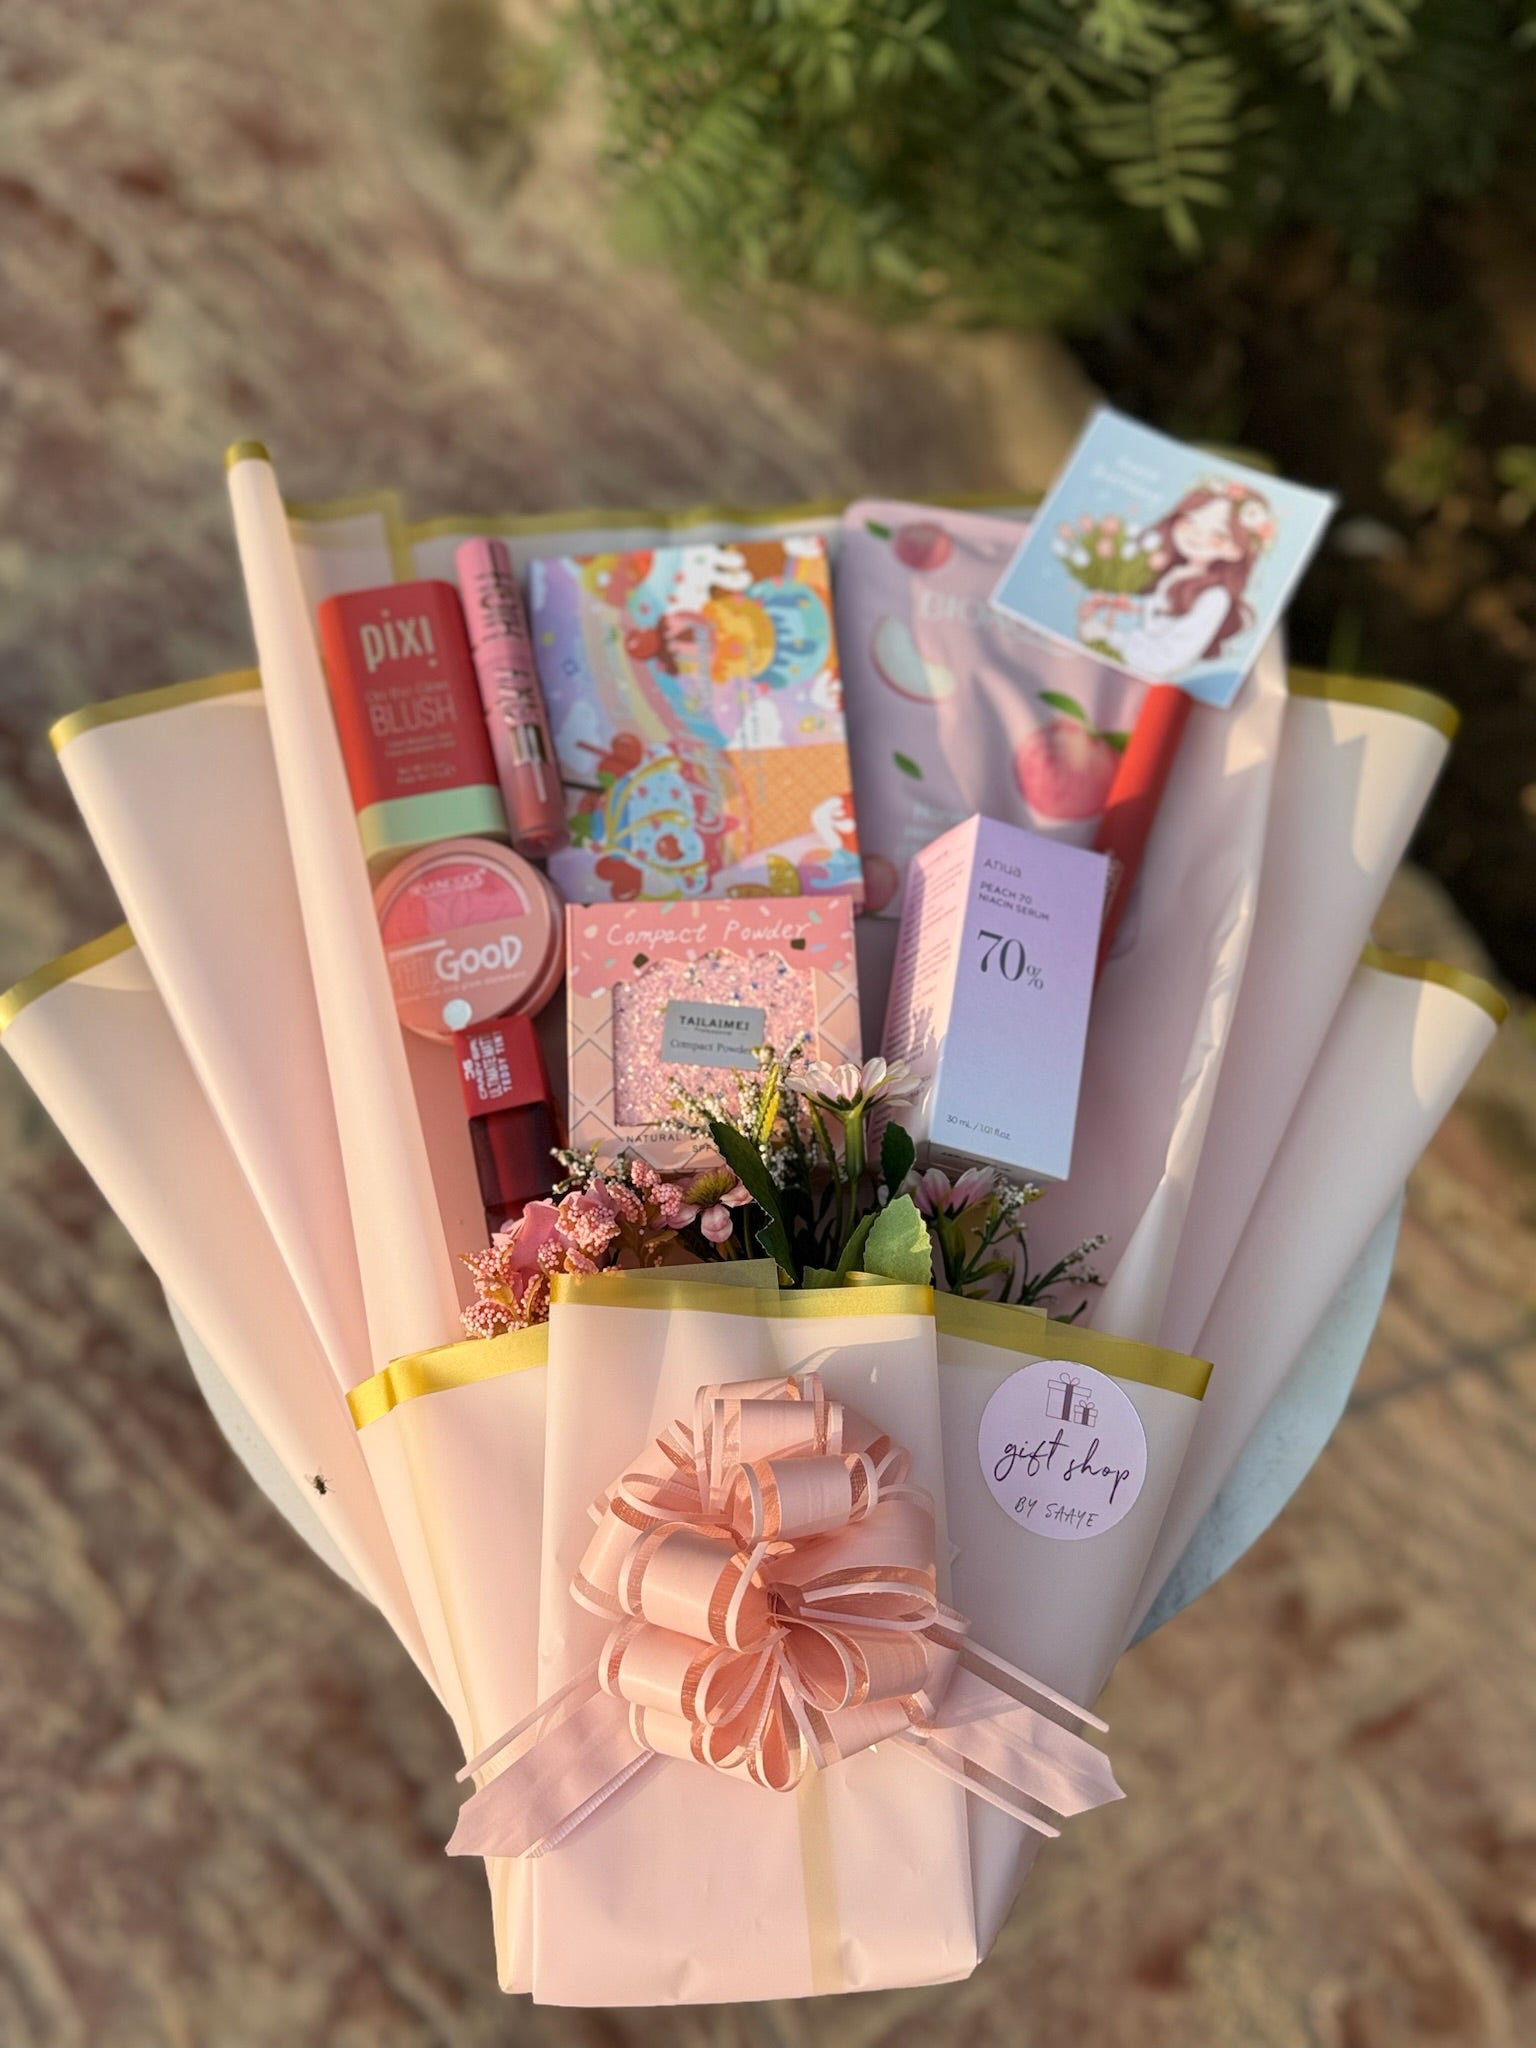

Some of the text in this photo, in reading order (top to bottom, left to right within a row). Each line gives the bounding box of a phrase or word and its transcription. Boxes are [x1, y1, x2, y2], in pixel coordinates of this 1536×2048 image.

[369, 693, 457, 736] BLUSH
[978, 893, 1050, 921] NIACIN SERUM
[980, 881, 1032, 904] PEACH 70
[606, 919, 811, 949] Compact Powder
[435, 934, 523, 981] GOOD
[680, 1015, 749, 1032] TAILAIMEI
[670, 1039, 713, 1052] Compact
[498, 1058, 513, 1093] TEDDY
[945, 1113, 958, 1125] 30
[626, 1133, 681, 1143] NATURAL
[994, 1427, 1130, 1505] gift shop
[1014, 1496, 1099, 1529] BY SAAYE
